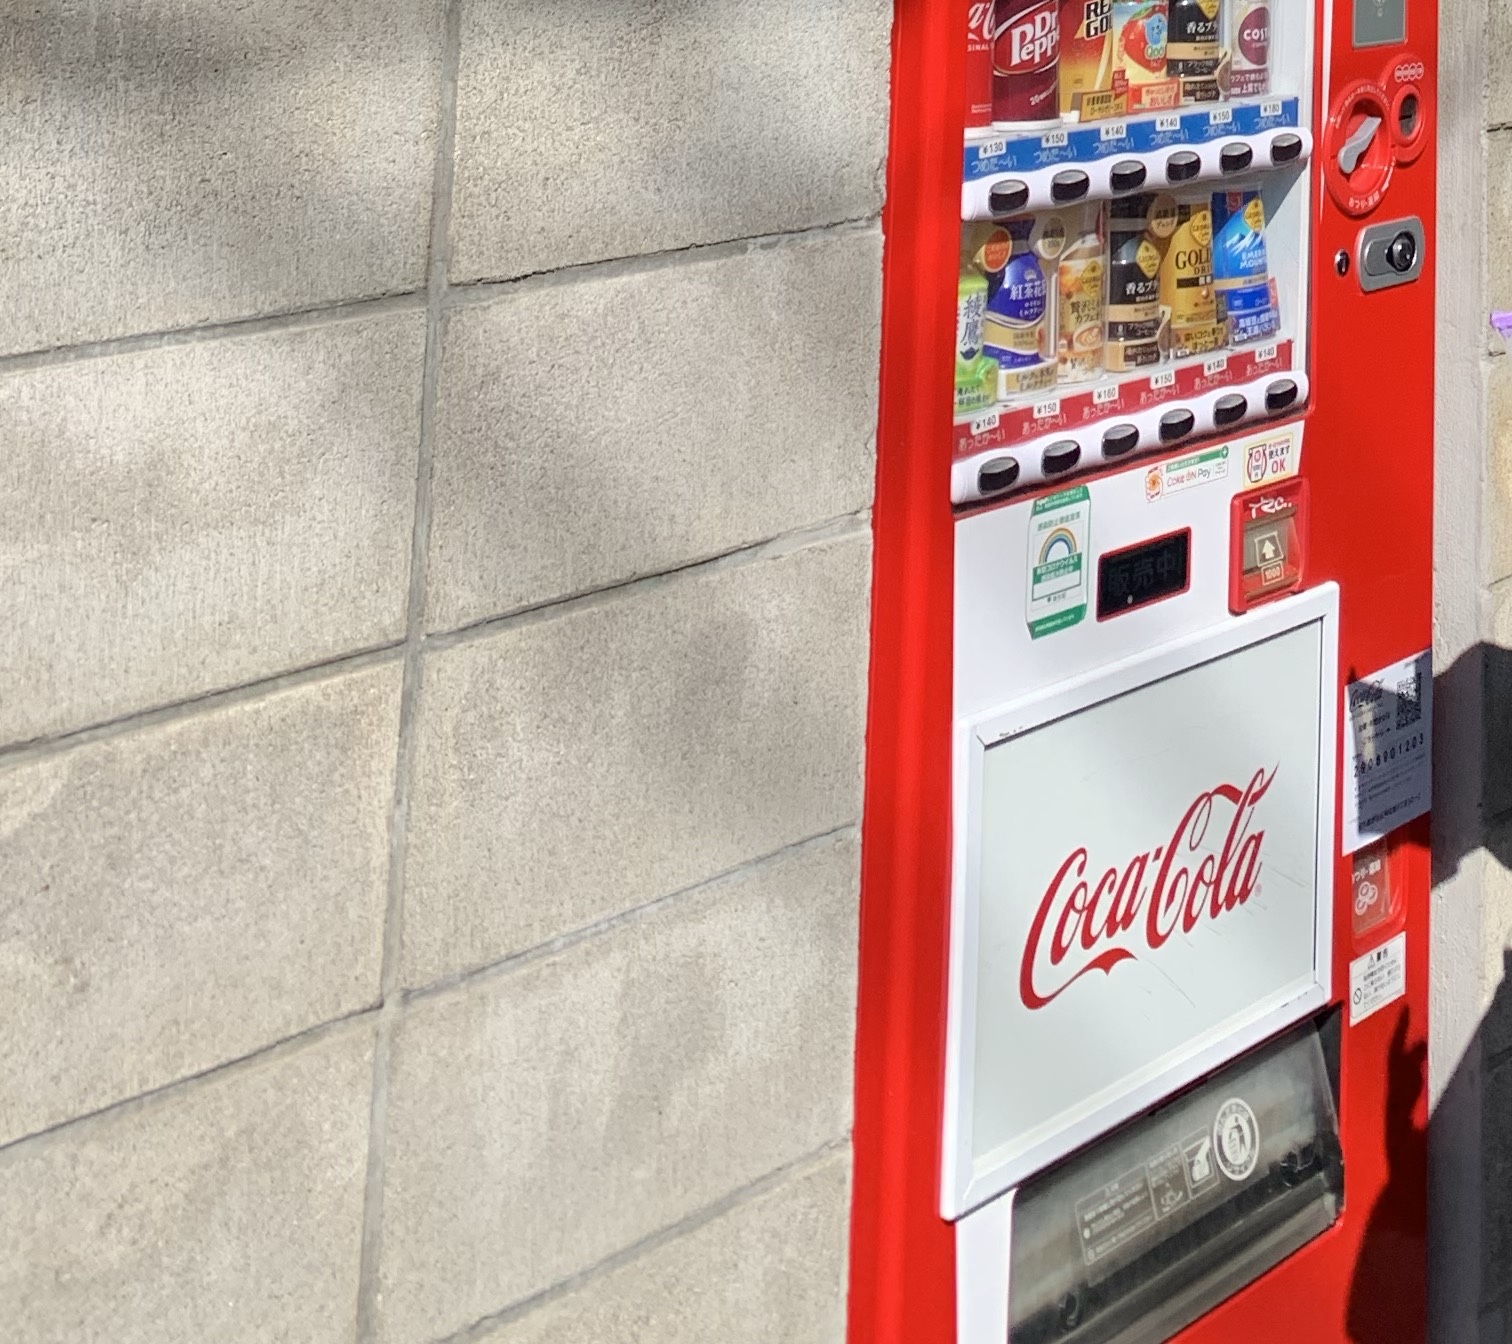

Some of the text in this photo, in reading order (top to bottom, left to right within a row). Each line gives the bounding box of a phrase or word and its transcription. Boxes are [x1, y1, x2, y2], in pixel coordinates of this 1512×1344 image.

[1145, 47, 1165, 60] Qoo
[1159, 117, 1177, 128] ¥140
[1105, 125, 1124, 136] ¥140
[1258, 346, 1275, 358] ¥140
[1206, 359, 1225, 373] ¥140
[1037, 402, 1057, 414] ¥150
[975, 414, 996, 430] ¥140
[1197, 467, 1211, 479] Pay
[1271, 459, 1286, 474] OK
[1265, 566, 1281, 580] 1000
[1019, 760, 1279, 1010] Coca-Cola
